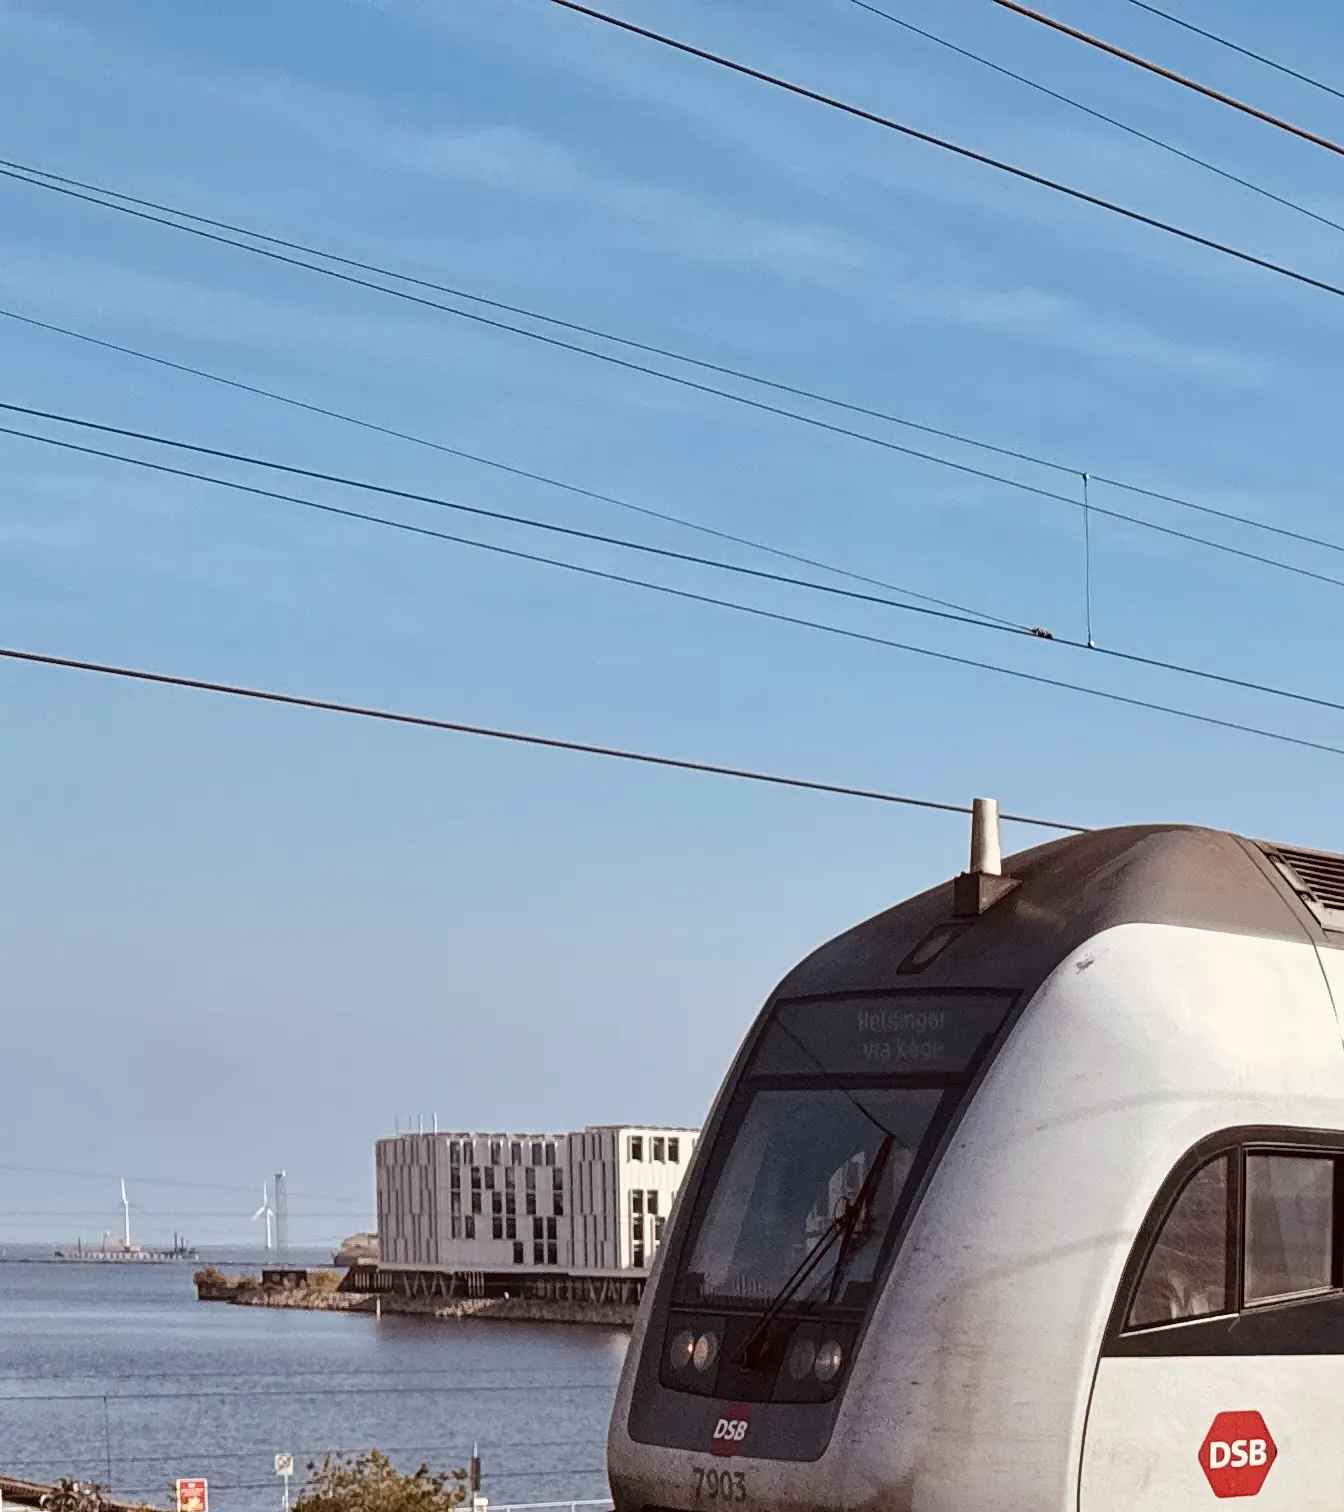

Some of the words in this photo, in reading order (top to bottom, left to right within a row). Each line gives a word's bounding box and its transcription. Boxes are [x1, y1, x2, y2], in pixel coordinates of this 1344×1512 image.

[713, 1418, 749, 1441] DSB
[1208, 1438, 1268, 1470] DSB
[693, 1466, 748, 1503] 7903
